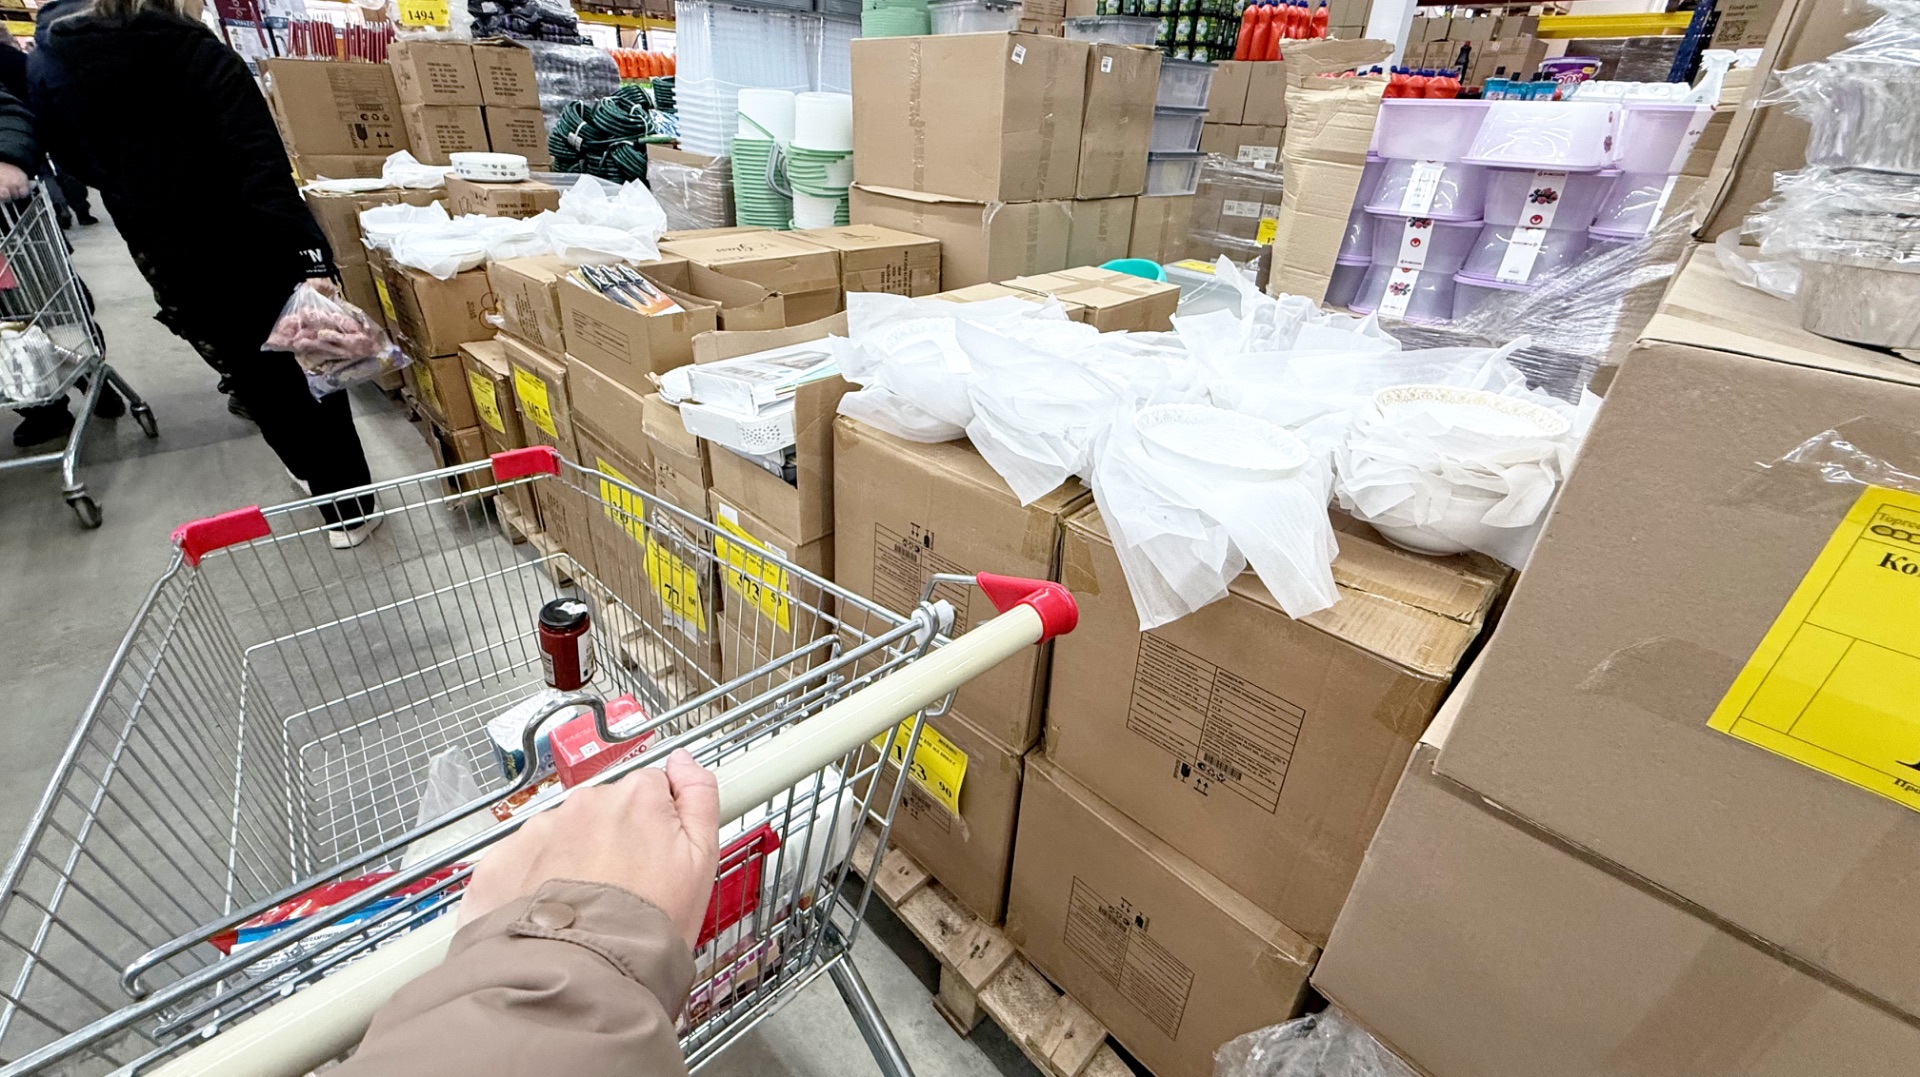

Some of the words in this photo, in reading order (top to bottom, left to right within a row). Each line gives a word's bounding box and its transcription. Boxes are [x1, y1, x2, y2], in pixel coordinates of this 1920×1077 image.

[408, 10, 435, 21] 1494
[1876, 552, 1920, 577] Ко
[938, 781, 952, 798] 90
